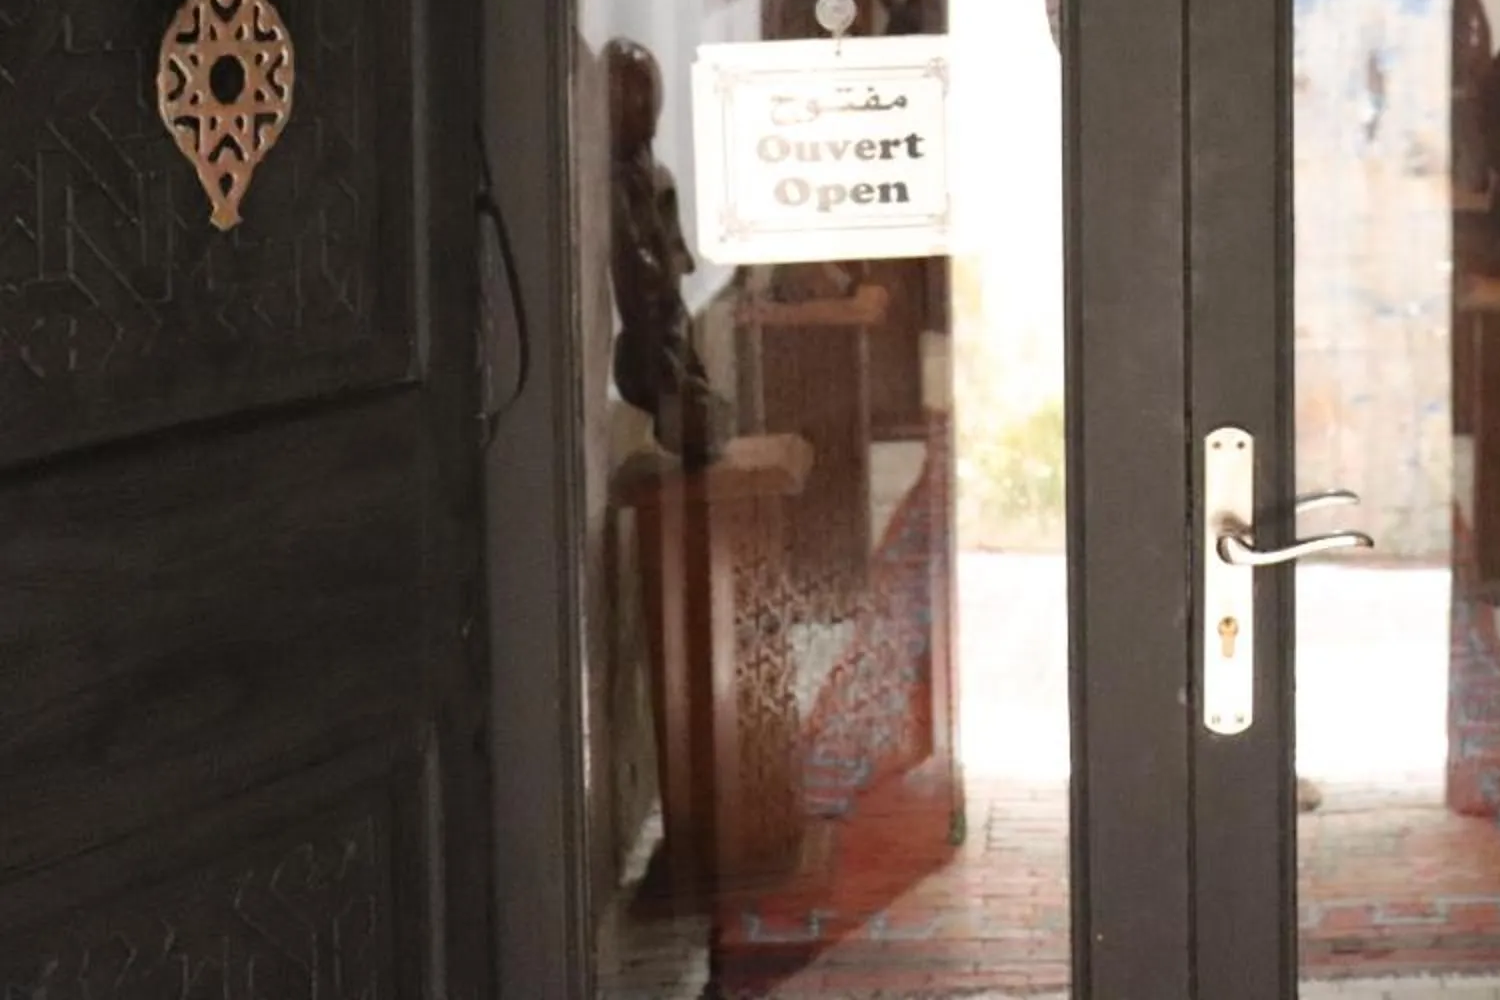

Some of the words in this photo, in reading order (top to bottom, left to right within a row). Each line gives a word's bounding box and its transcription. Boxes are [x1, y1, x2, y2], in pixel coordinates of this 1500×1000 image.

[771, 86, 908, 126] مفتوح
[756, 132, 925, 163] Ouvert
[774, 178, 910, 212] Open
